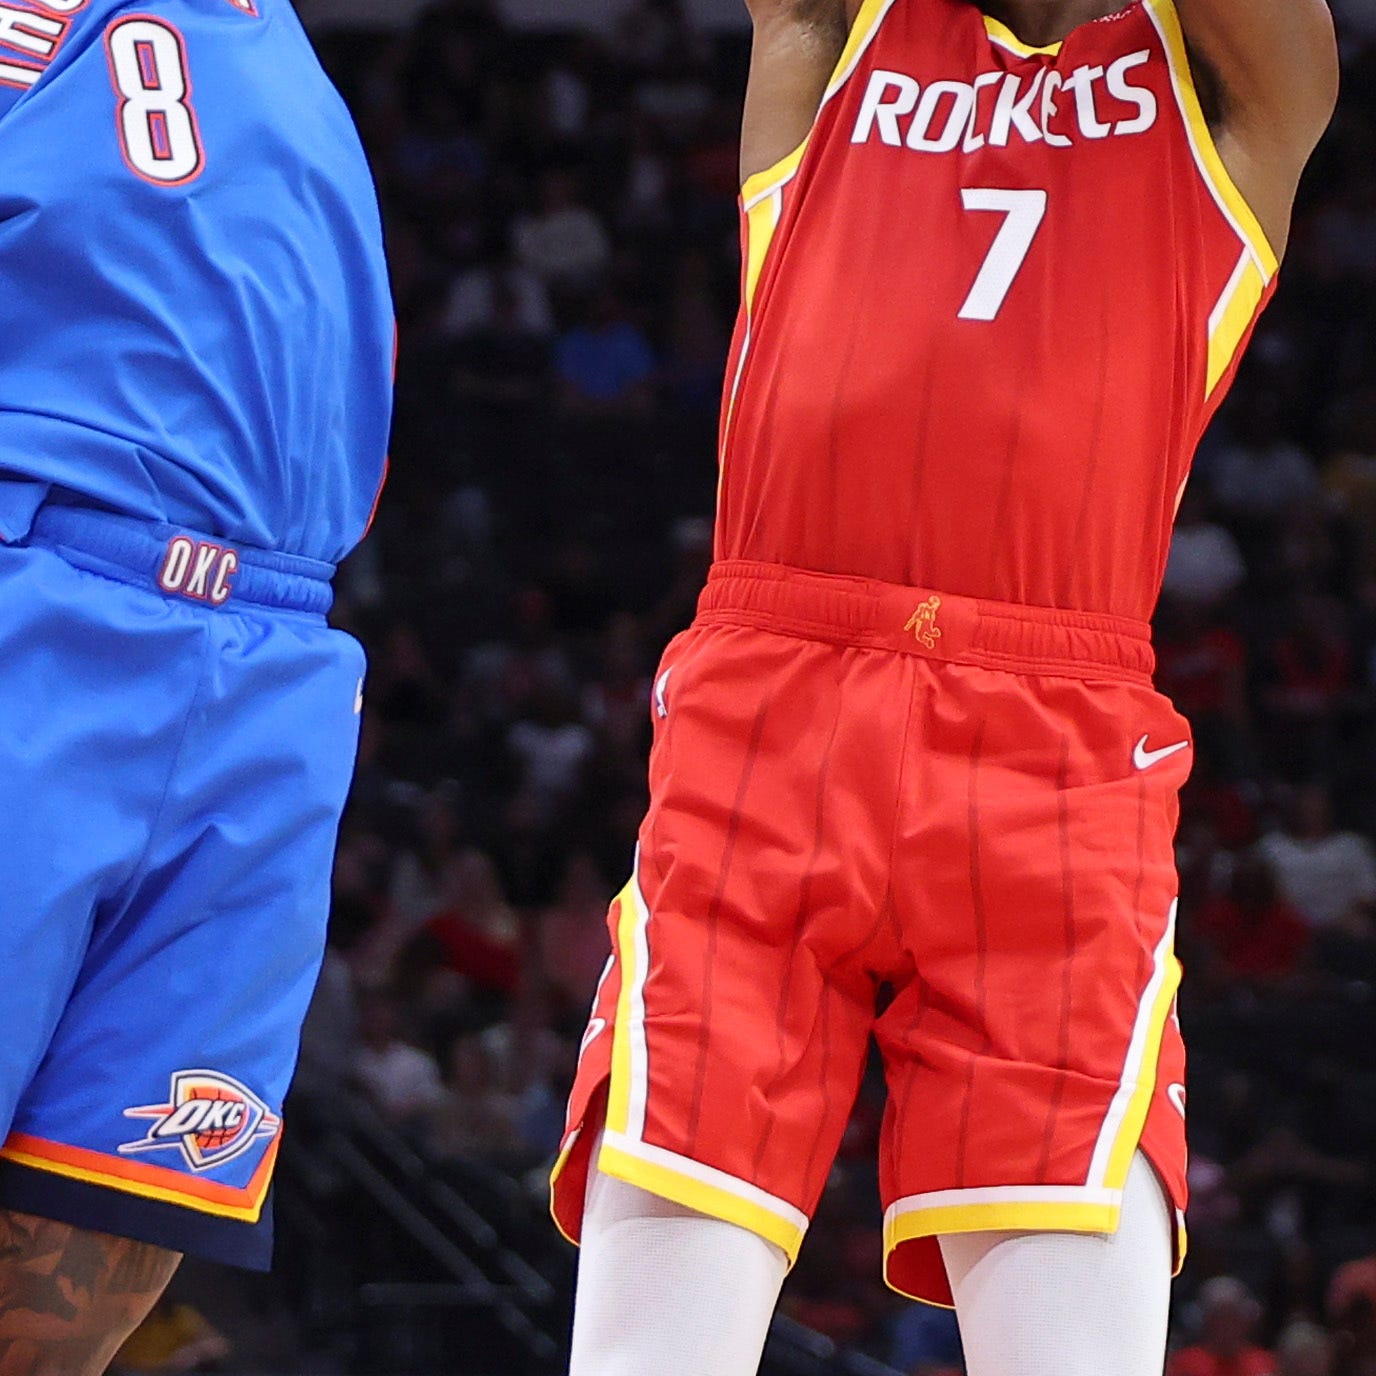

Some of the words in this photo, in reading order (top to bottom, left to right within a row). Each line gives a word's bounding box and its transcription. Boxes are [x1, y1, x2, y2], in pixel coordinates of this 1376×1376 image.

[104, 13, 206, 187] 8
[850, 48, 1157, 154] ROCKETS
[957, 187, 1048, 321] 7
[157, 535, 239, 605] OKC
[152, 1098, 247, 1139] OKC
